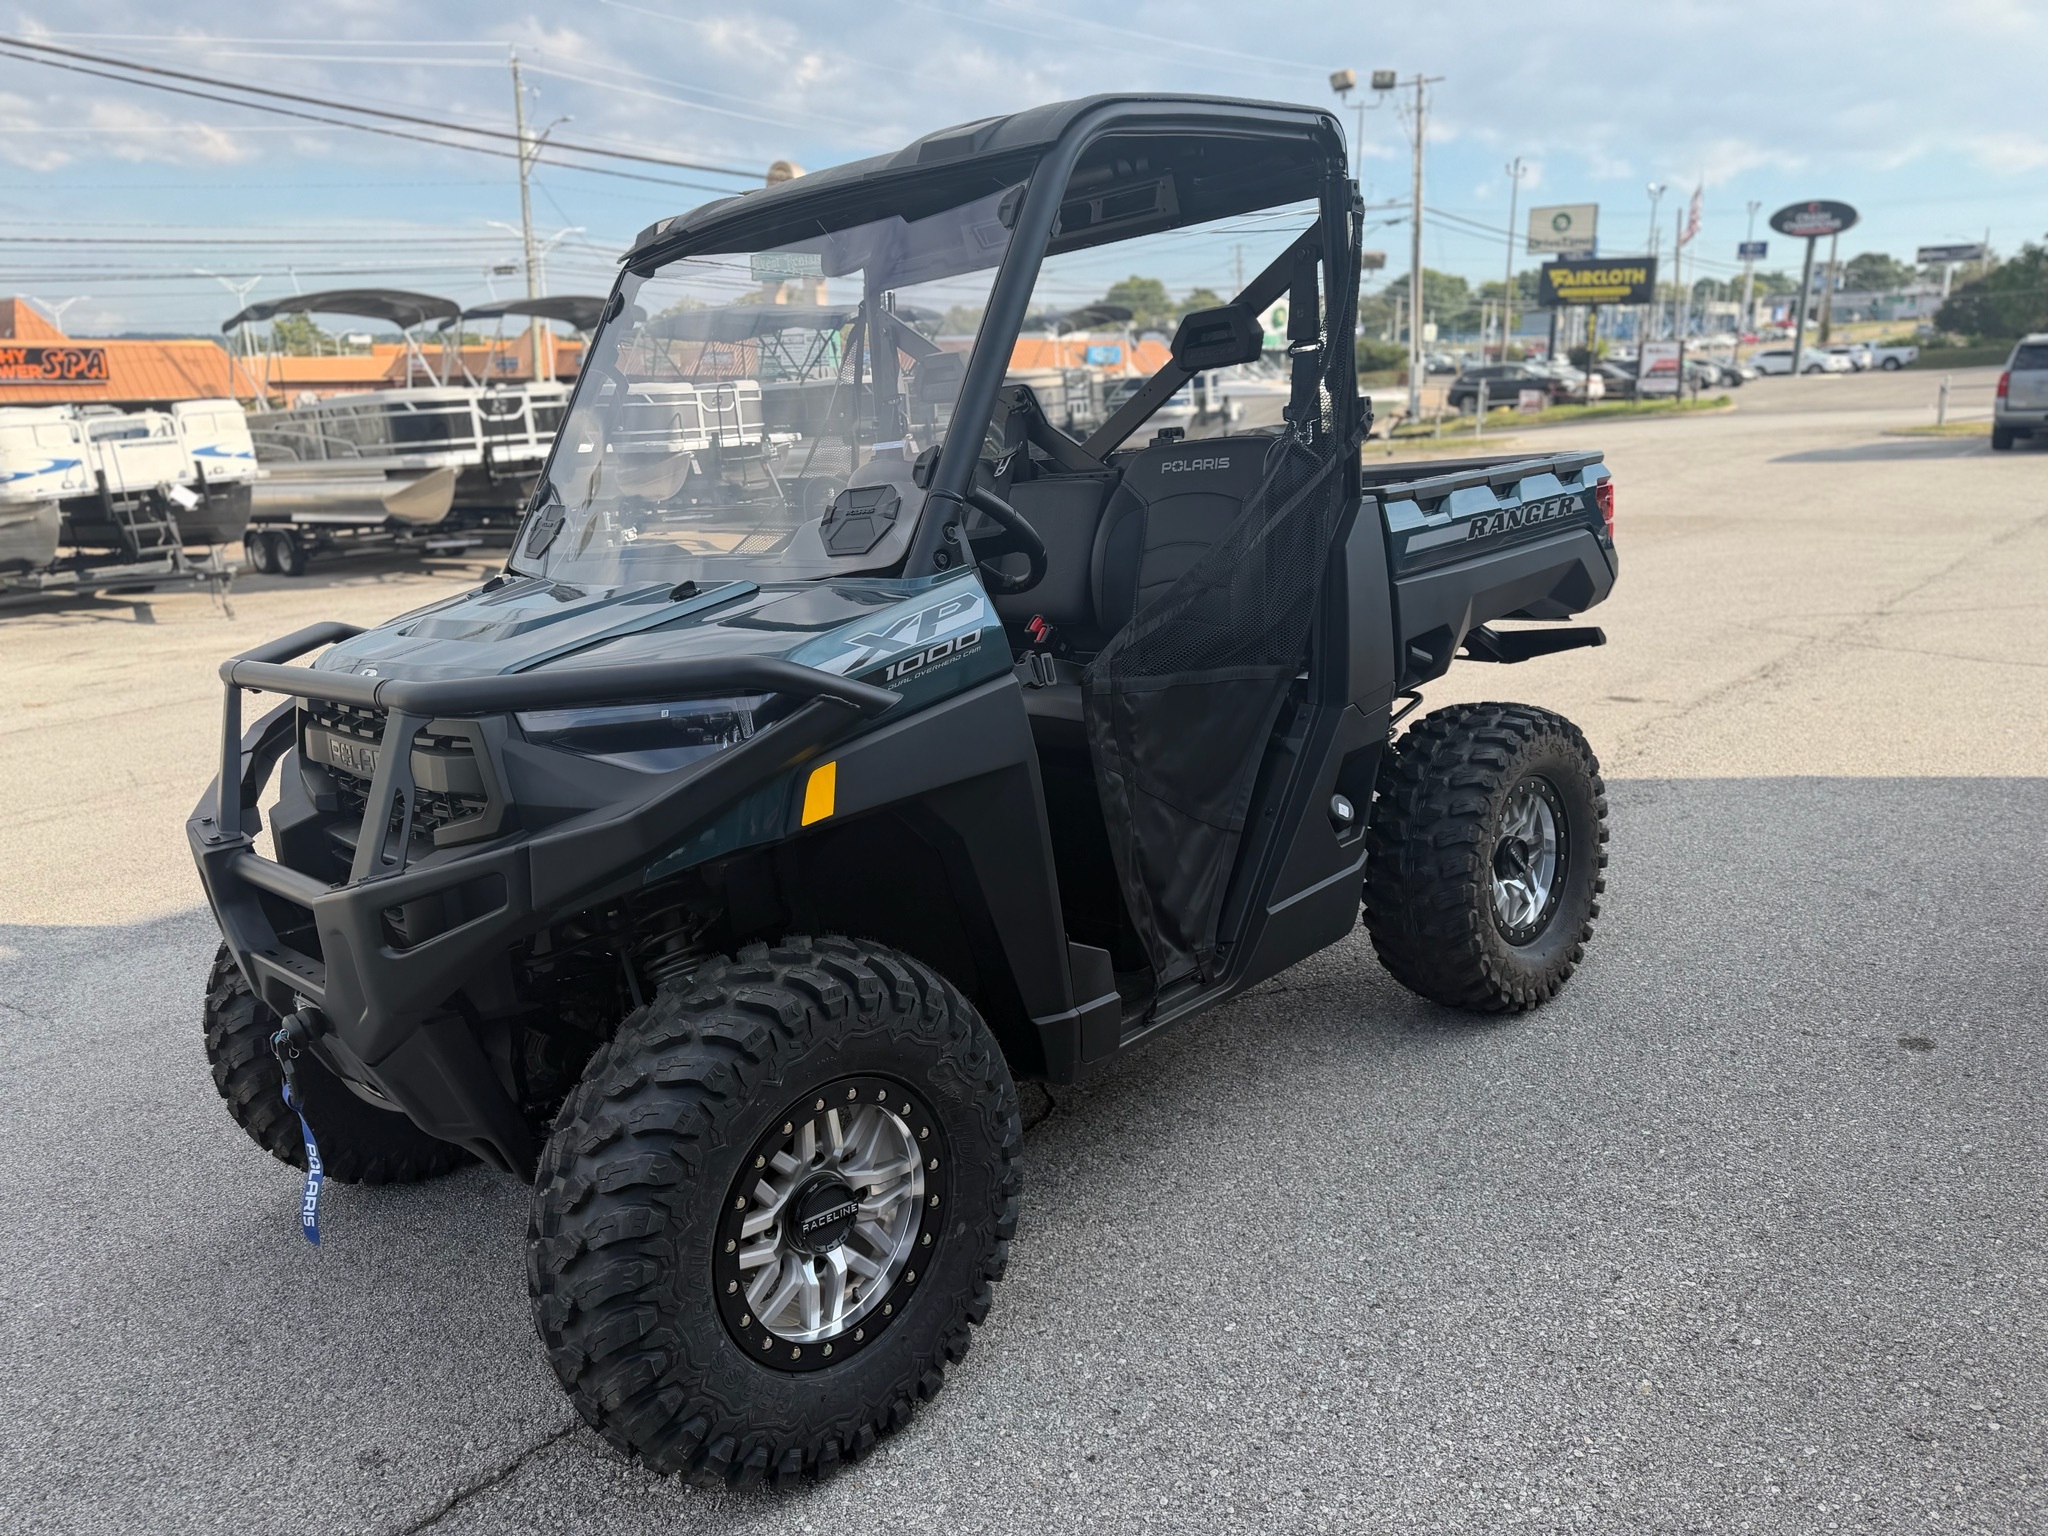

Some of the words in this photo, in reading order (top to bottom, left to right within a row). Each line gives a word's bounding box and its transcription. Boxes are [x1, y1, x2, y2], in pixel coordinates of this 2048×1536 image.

[1548, 268, 1647, 288] FAIRCLOTH
[41, 348, 107, 379] SPA
[1161, 457, 1230, 474] POLARIS
[1466, 495, 1577, 541] RANGER
[841, 592, 985, 676] XP
[885, 628, 981, 682] 1000
[887, 677, 913, 691] DUAL
[914, 654, 962, 680] OVERHEAD
[962, 645, 982, 658] CAM
[330, 739, 380, 773] POLA
[303, 1142, 322, 1227] POLARIS
[802, 1203, 858, 1233] RACELINE
